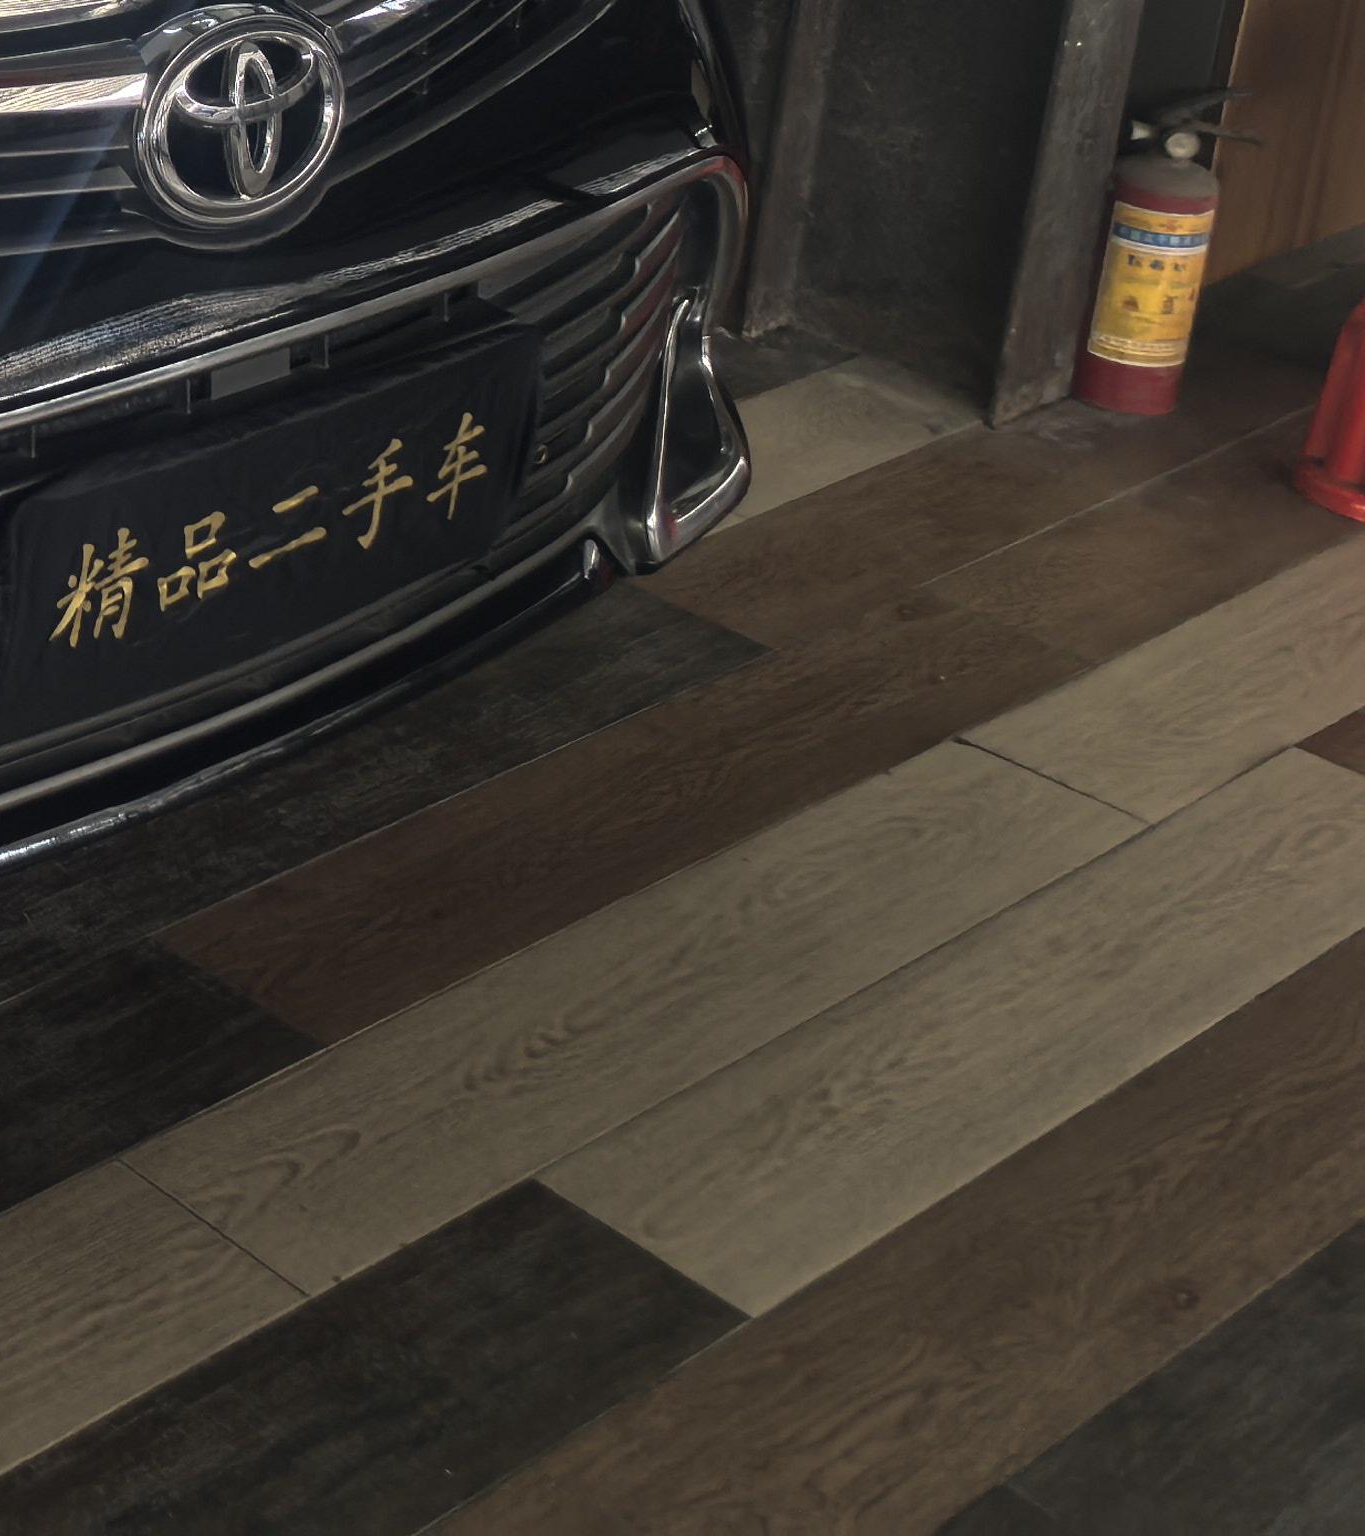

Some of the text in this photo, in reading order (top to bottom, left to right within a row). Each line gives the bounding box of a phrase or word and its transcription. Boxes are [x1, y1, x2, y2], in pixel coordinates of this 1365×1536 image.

[49, 412, 488, 649] 精品二手车
